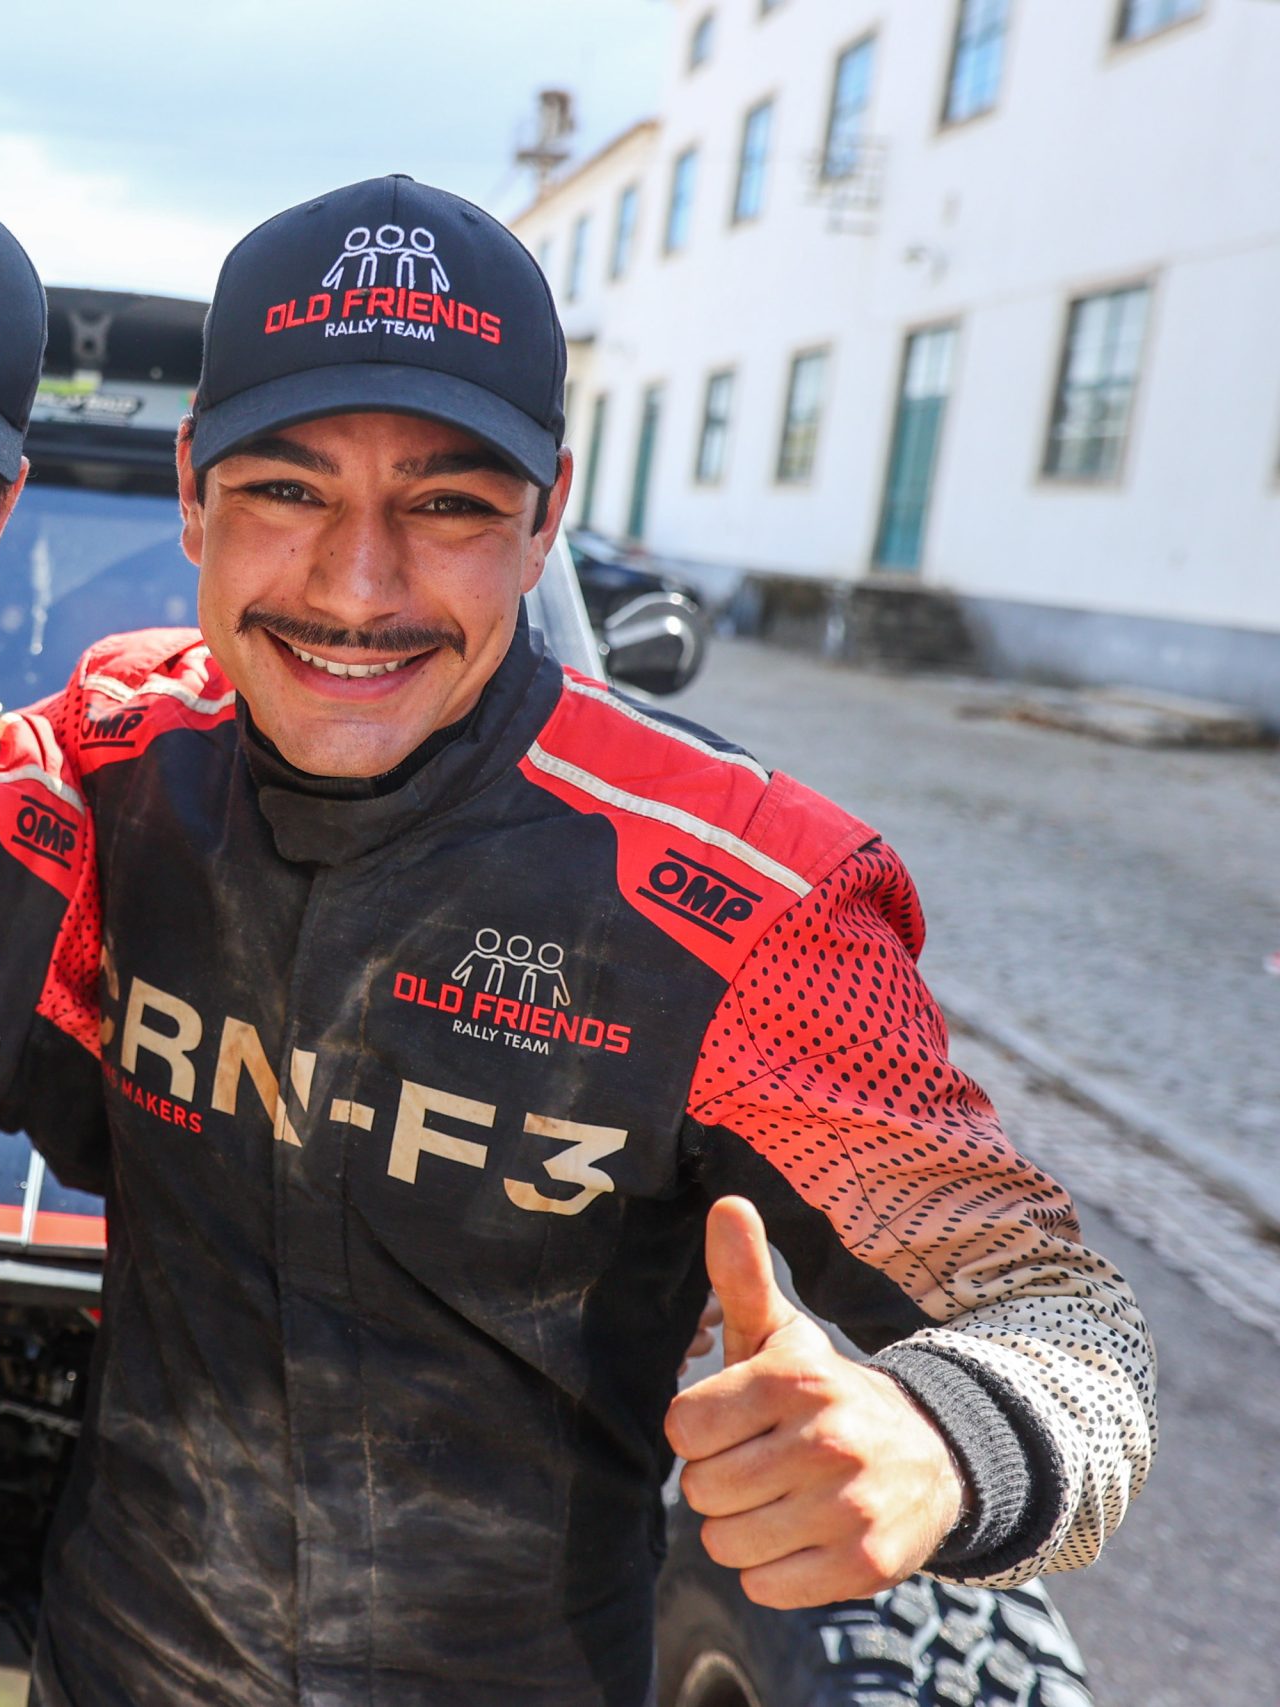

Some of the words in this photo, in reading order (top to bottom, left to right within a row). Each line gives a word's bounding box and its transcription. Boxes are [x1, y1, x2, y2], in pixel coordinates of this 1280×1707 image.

[264, 293, 331, 334] OLD
[342, 287, 501, 345] FRIENDS
[324, 318, 379, 338] RALLY
[382, 319, 435, 342] TEAM
[17, 806, 76, 857] OMP
[648, 861, 754, 925] OMP
[393, 972, 464, 1014] OLD
[472, 991, 633, 1055] FRIENDS
[452, 1019, 499, 1043] RALLY
[503, 1031, 549, 1056] TEAM
[100, 945, 629, 1216] RN-F3
[121, 1076, 203, 1134] MAKERS
